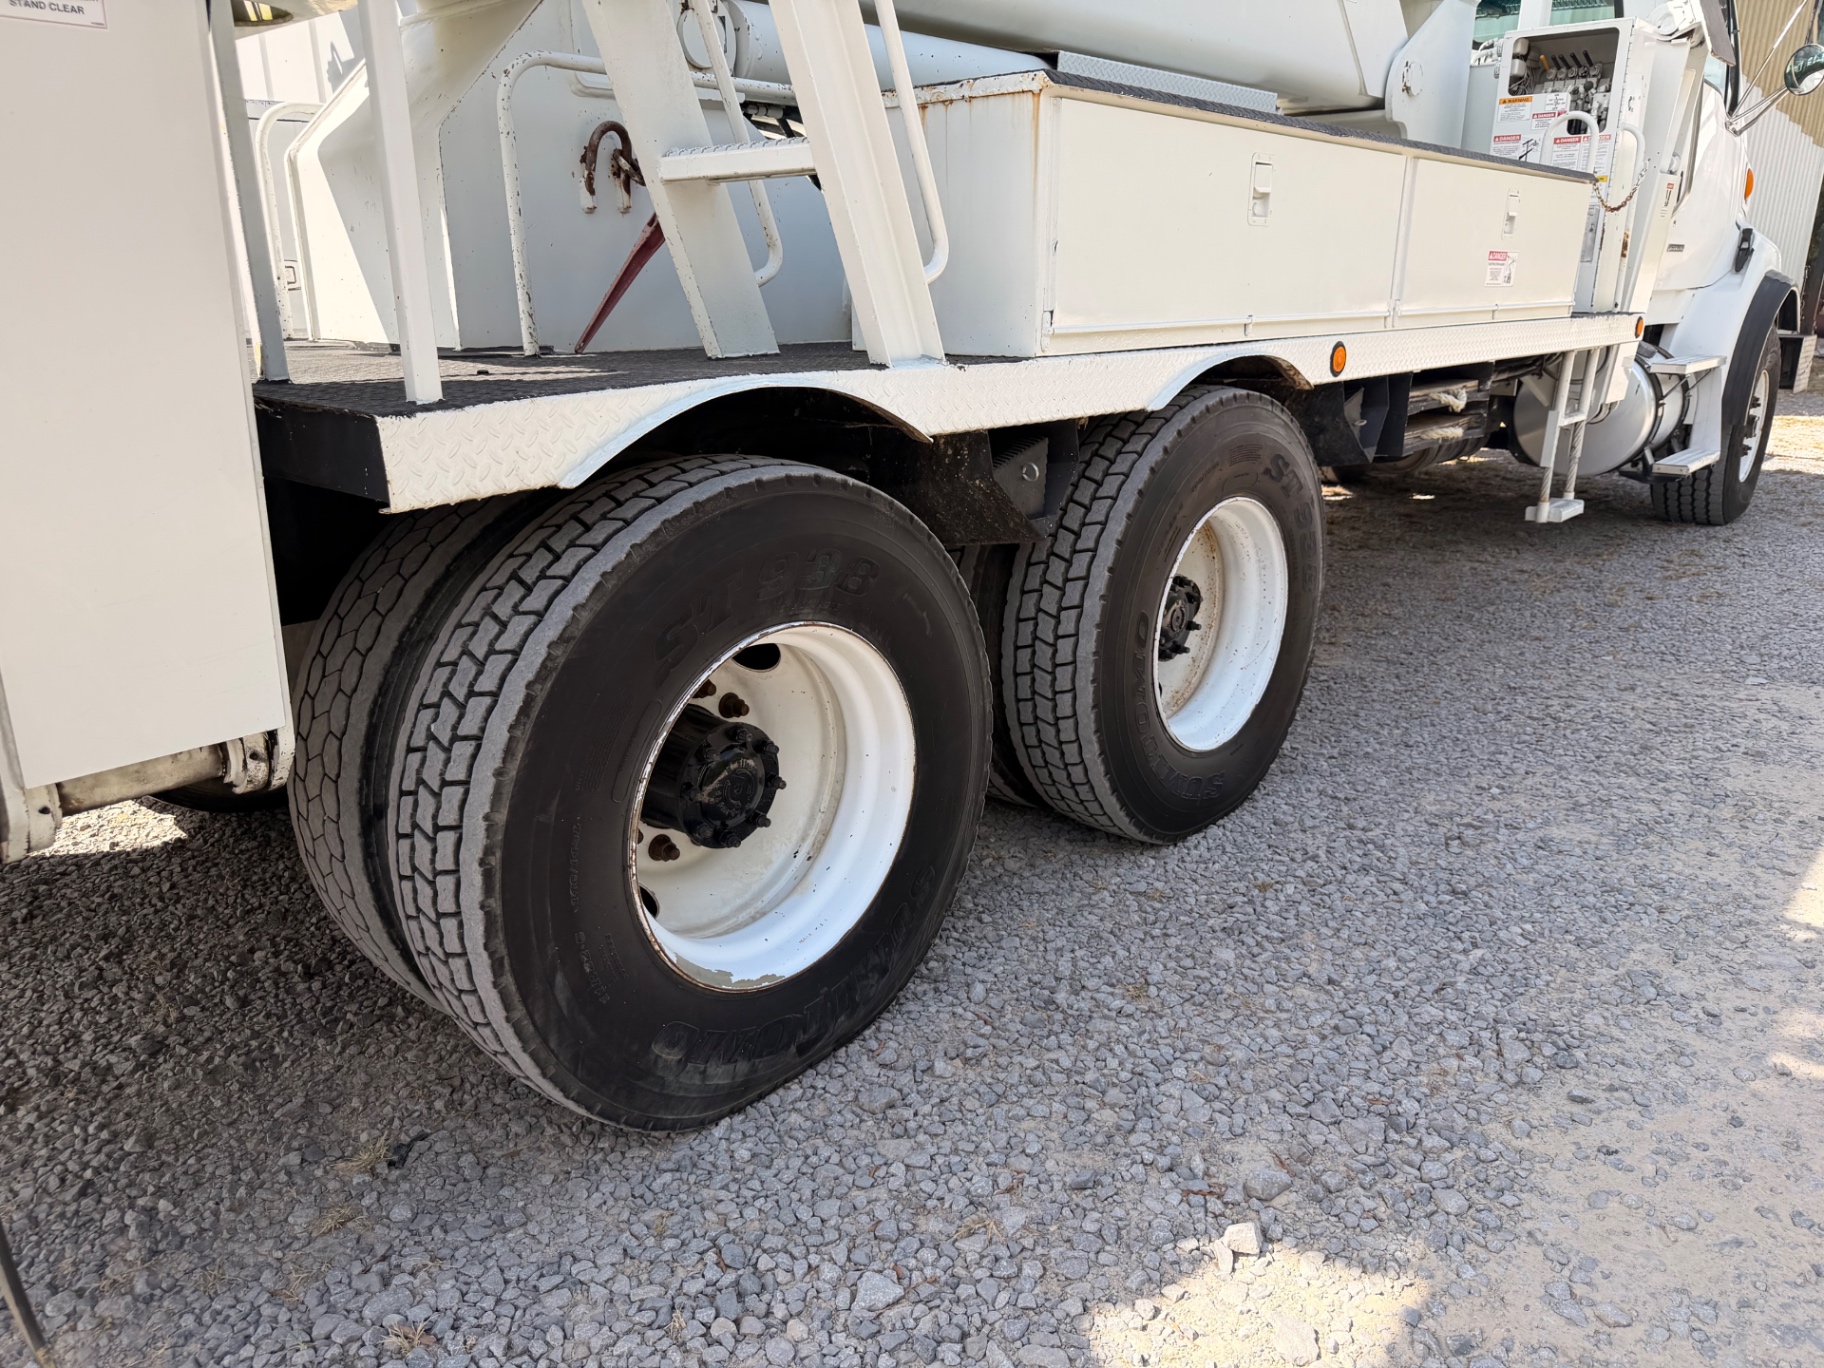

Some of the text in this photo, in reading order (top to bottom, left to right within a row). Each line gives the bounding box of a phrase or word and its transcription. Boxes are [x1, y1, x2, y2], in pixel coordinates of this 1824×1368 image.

[9, 0, 85, 15] STAND CLEAR
[1261, 453, 1303, 499] ST
[653, 548, 880, 688] ST 938
[1132, 611, 1226, 800] SUMITOMO
[573, 931, 610, 1006] 11R22.5
